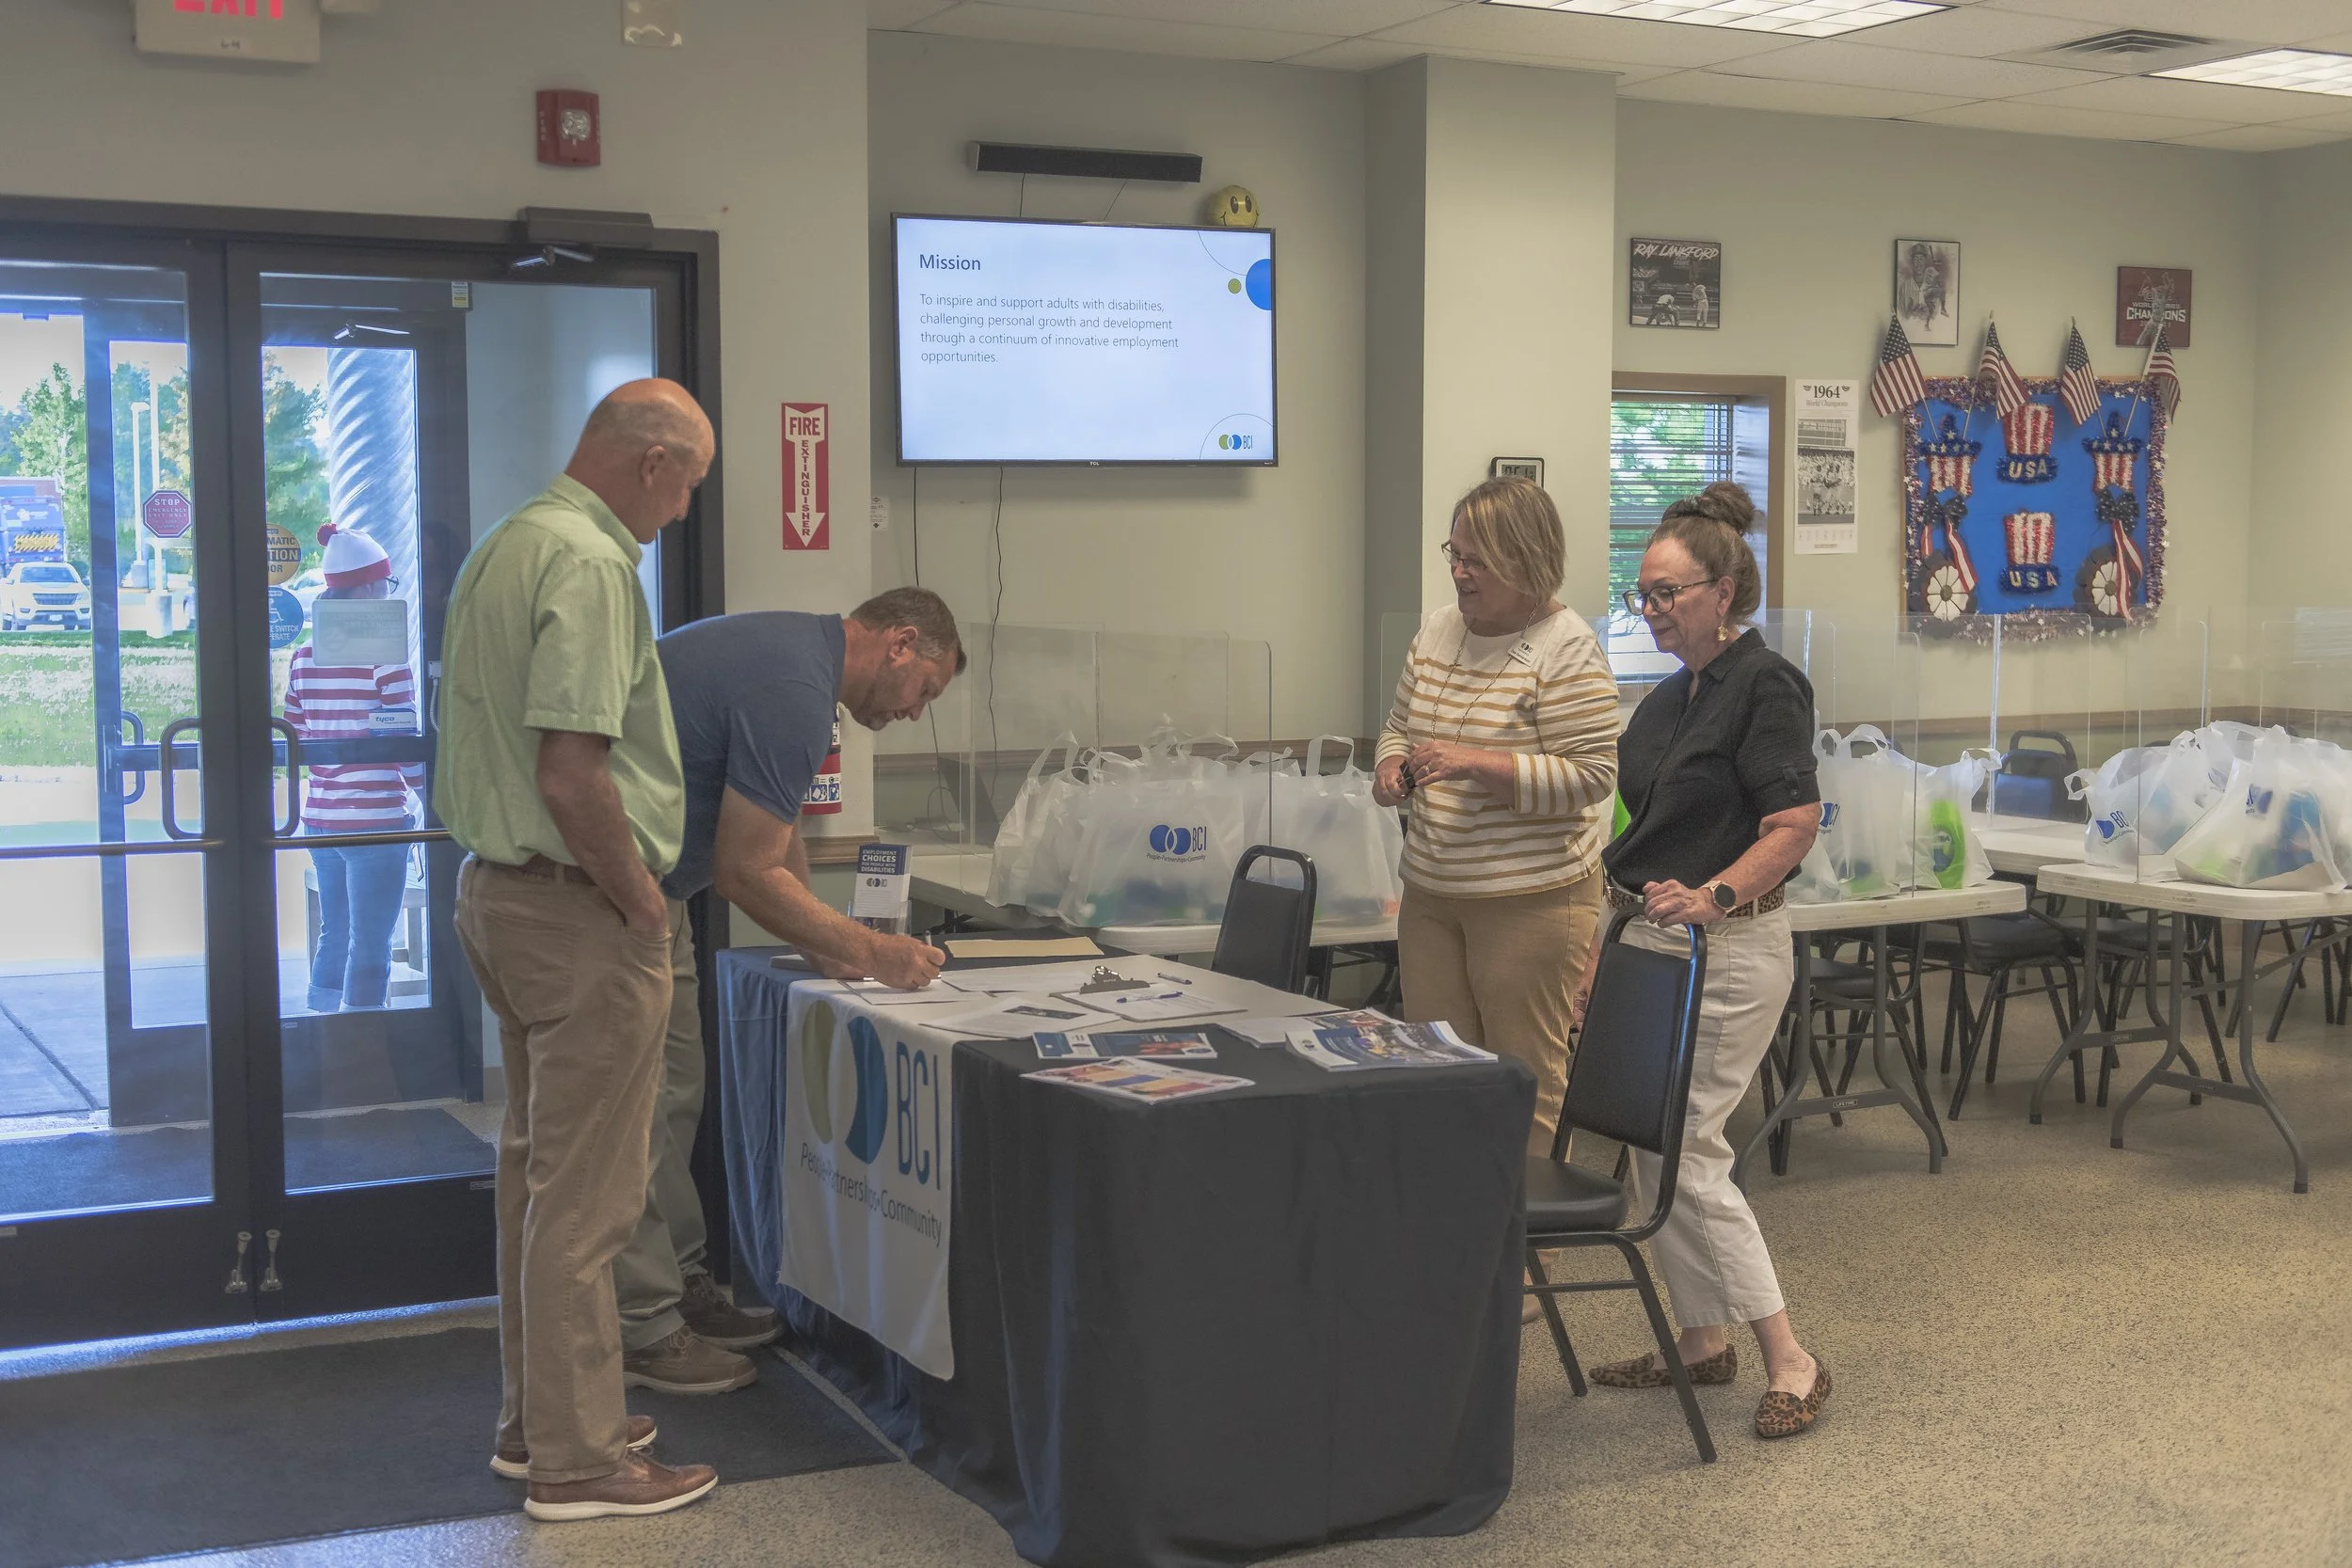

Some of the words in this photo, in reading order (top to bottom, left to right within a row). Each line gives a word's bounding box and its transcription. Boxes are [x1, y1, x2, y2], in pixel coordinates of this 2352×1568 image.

[1632, 243, 1659, 260] RAY
[1659, 245, 1720, 261] LANKFORD
[919, 254, 981, 271] Mission
[920, 293, 933, 306] To
[936, 294, 973, 309] inspire
[977, 295, 997, 308] and
[1000, 297, 1043, 310] support
[1046, 296, 1079, 309] adults
[1082, 298, 1104, 310] with
[1107, 298, 1165, 312] disabilities,
[920, 313, 984, 328] challenging
[988, 314, 1035, 329] personal
[1038, 316, 1076, 329] growth
[1080, 317, 1100, 328] and
[1103, 318, 1173, 331] development
[2126, 307, 2186, 323] CHAMONS
[920, 332, 965, 347] through
[969, 335, 976, 344] a
[978, 333, 1037, 345] continuum
[1041, 333, 1053, 345] of
[1055, 335, 1109, 346] innovative
[1112, 336, 1179, 350] employment
[920, 350, 999, 365] opportunities.
[1814, 385, 1841, 399] 1964
[789, 417, 820, 436] FIRE
[1243, 435, 1253, 450] BCI
[2009, 459, 2048, 479] USA
[801, 439, 810, 536] EXTINGUISHER
[267, 537, 295, 546] MATIC
[267, 549, 298, 561] TION
[268, 564, 283, 573] OR
[2009, 571, 2058, 589] USA
[269, 632, 291, 641] ERATE
[1192, 826, 1207, 852] BCI
[862, 854, 897, 863] CHOICES
[861, 865, 896, 874] DISABILITIES
[897, 1040, 941, 1192] BCI
[881, 1189, 942, 1247] Community
